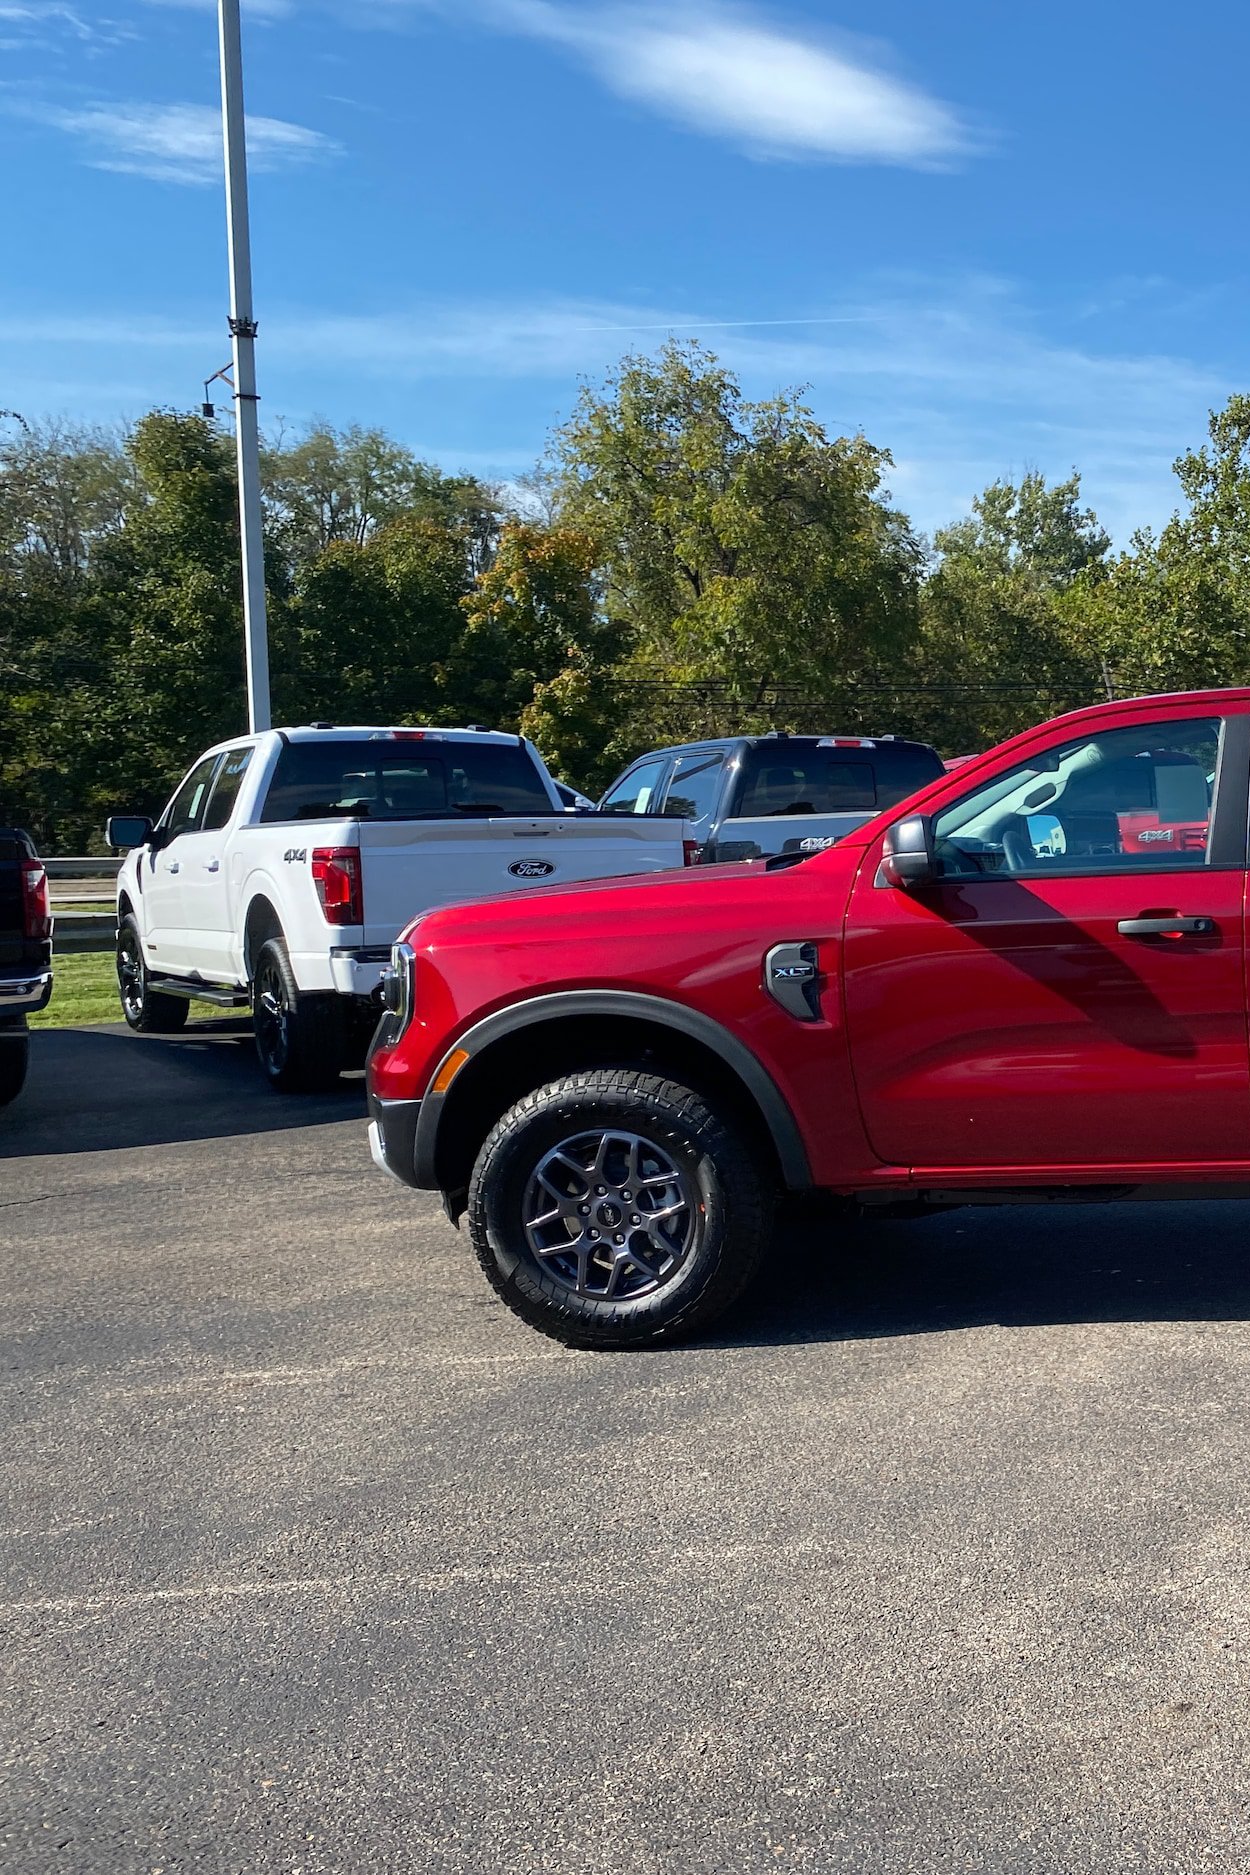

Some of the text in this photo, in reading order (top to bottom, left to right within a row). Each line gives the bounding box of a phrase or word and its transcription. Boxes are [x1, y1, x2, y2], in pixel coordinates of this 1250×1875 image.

[283, 848, 307, 864] 4X4
[516, 862, 548, 875] Ford
[775, 967, 811, 978] XLT
